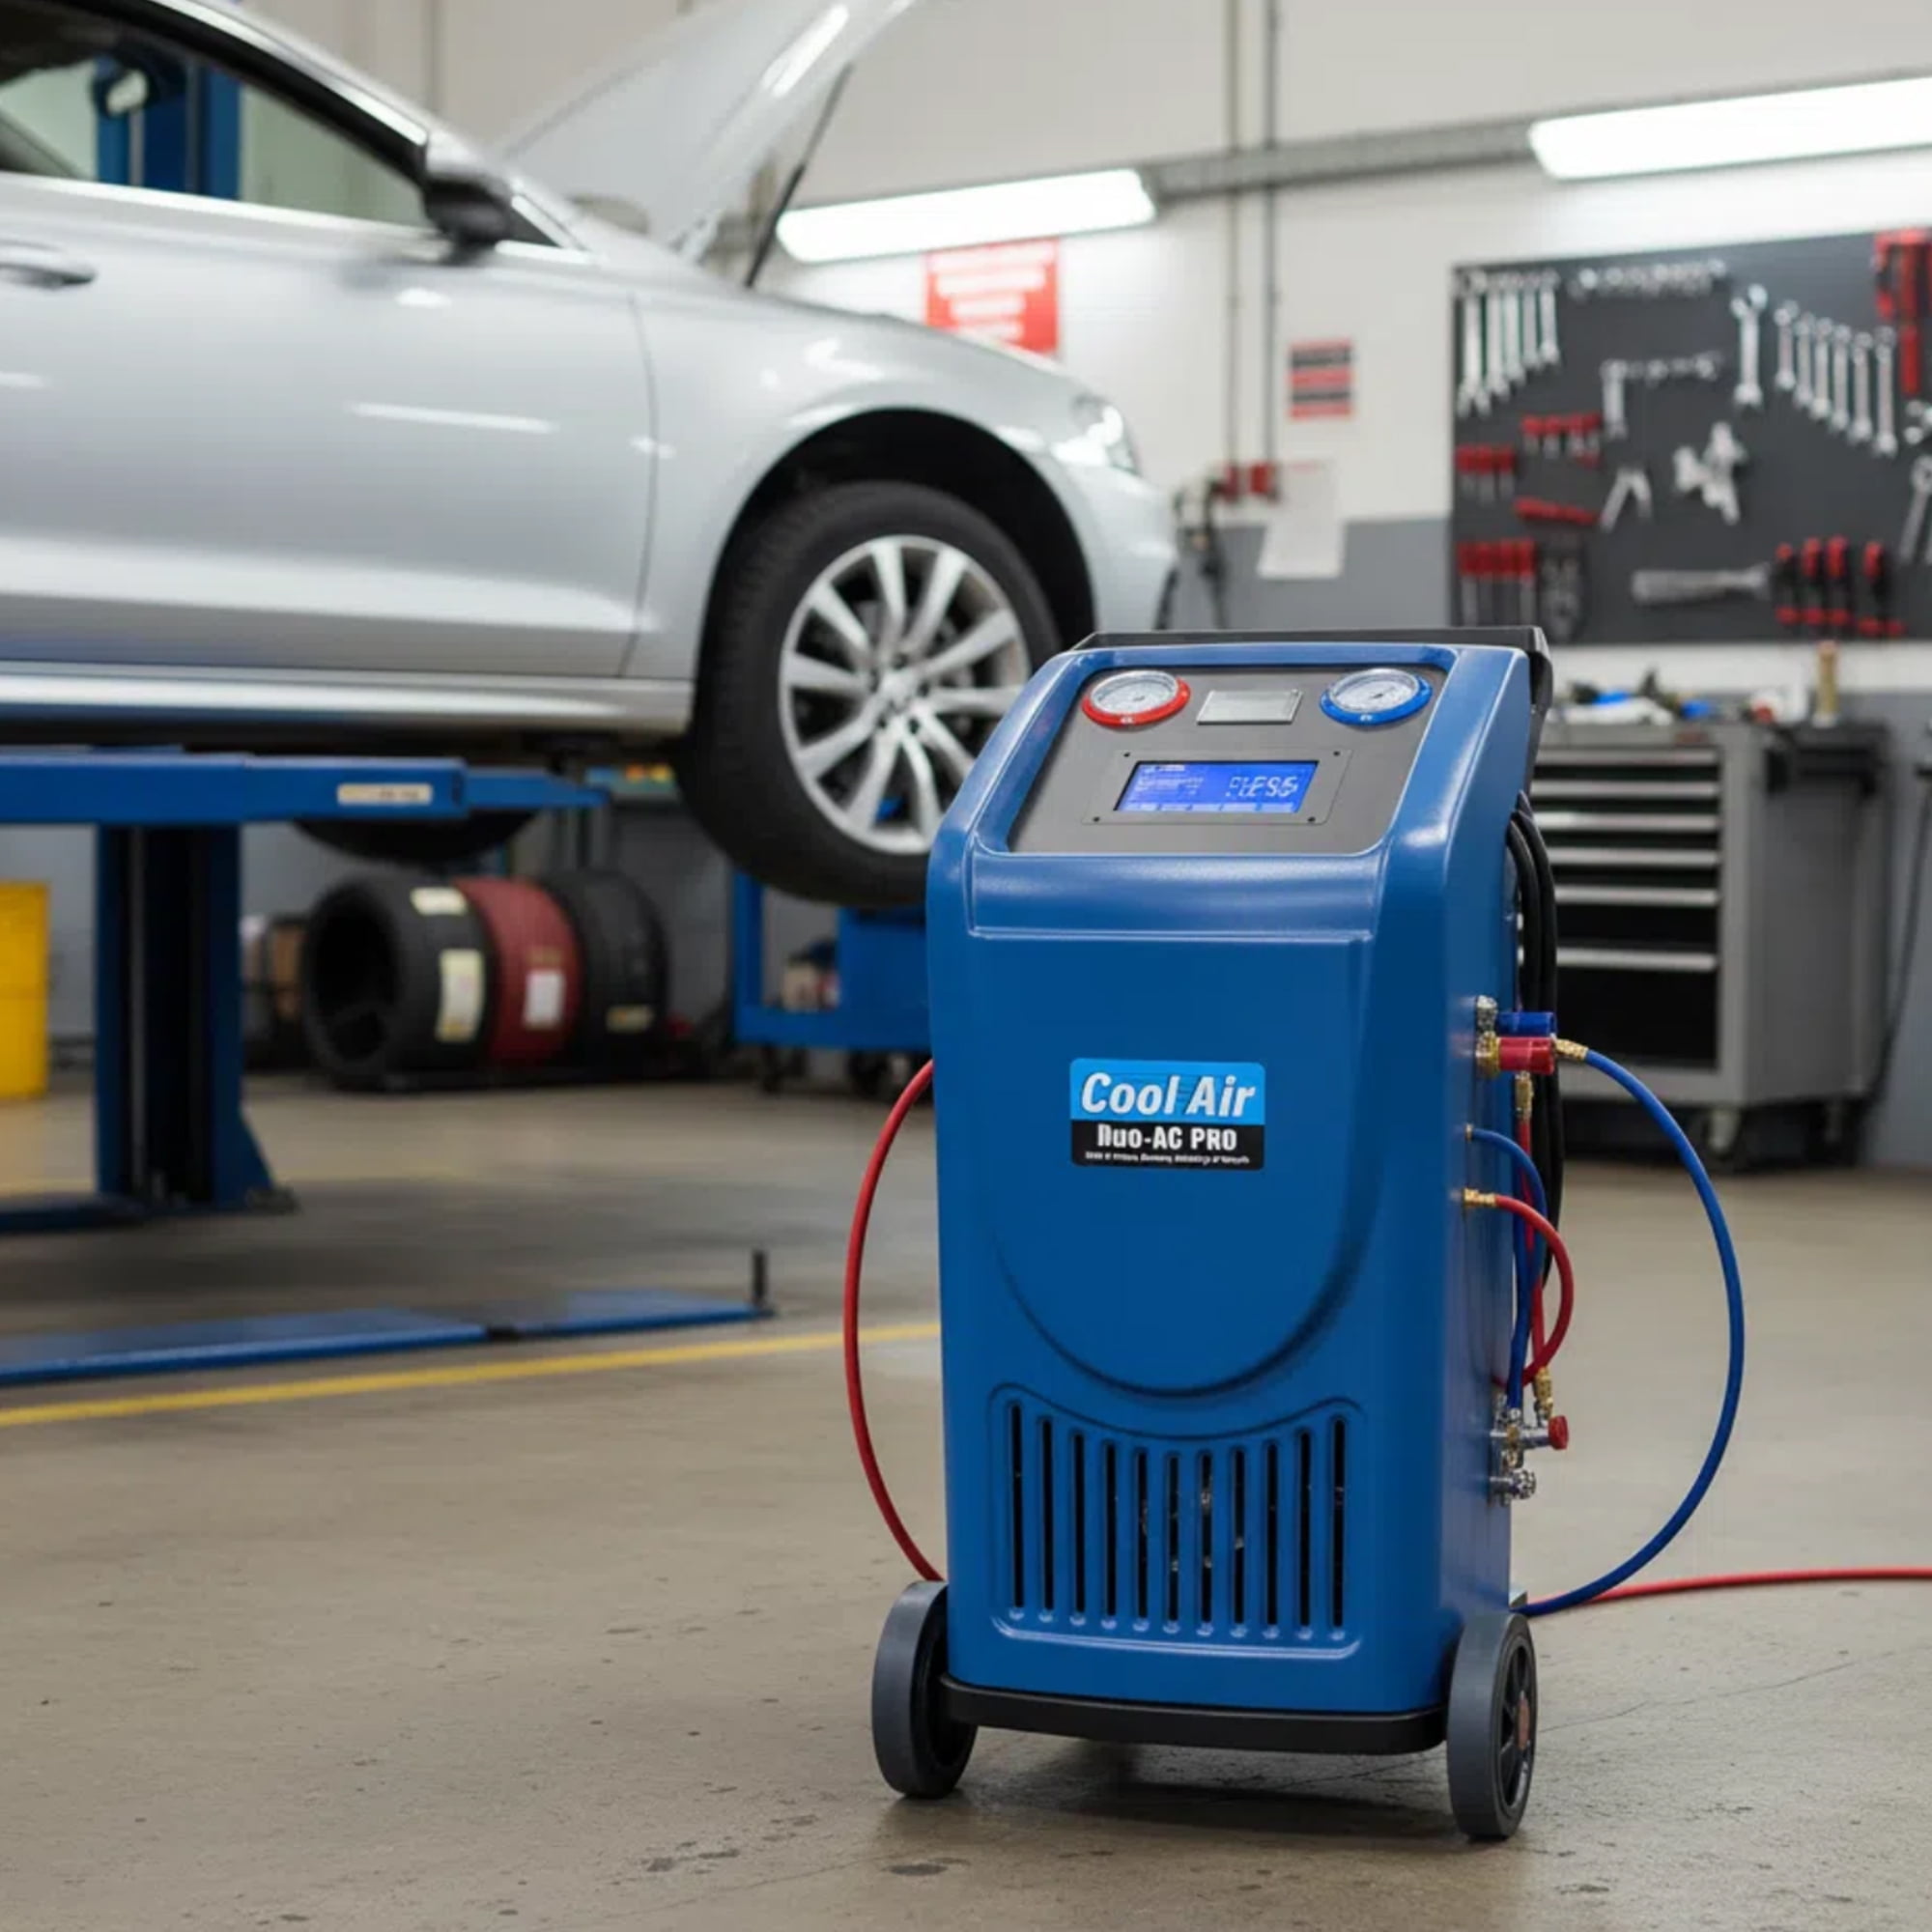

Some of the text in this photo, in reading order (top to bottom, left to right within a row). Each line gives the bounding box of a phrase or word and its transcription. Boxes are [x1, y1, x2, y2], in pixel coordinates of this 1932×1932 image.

[1081, 1072, 1256, 1117] Cool Air
[1190, 1127, 1237, 1151] PRO
